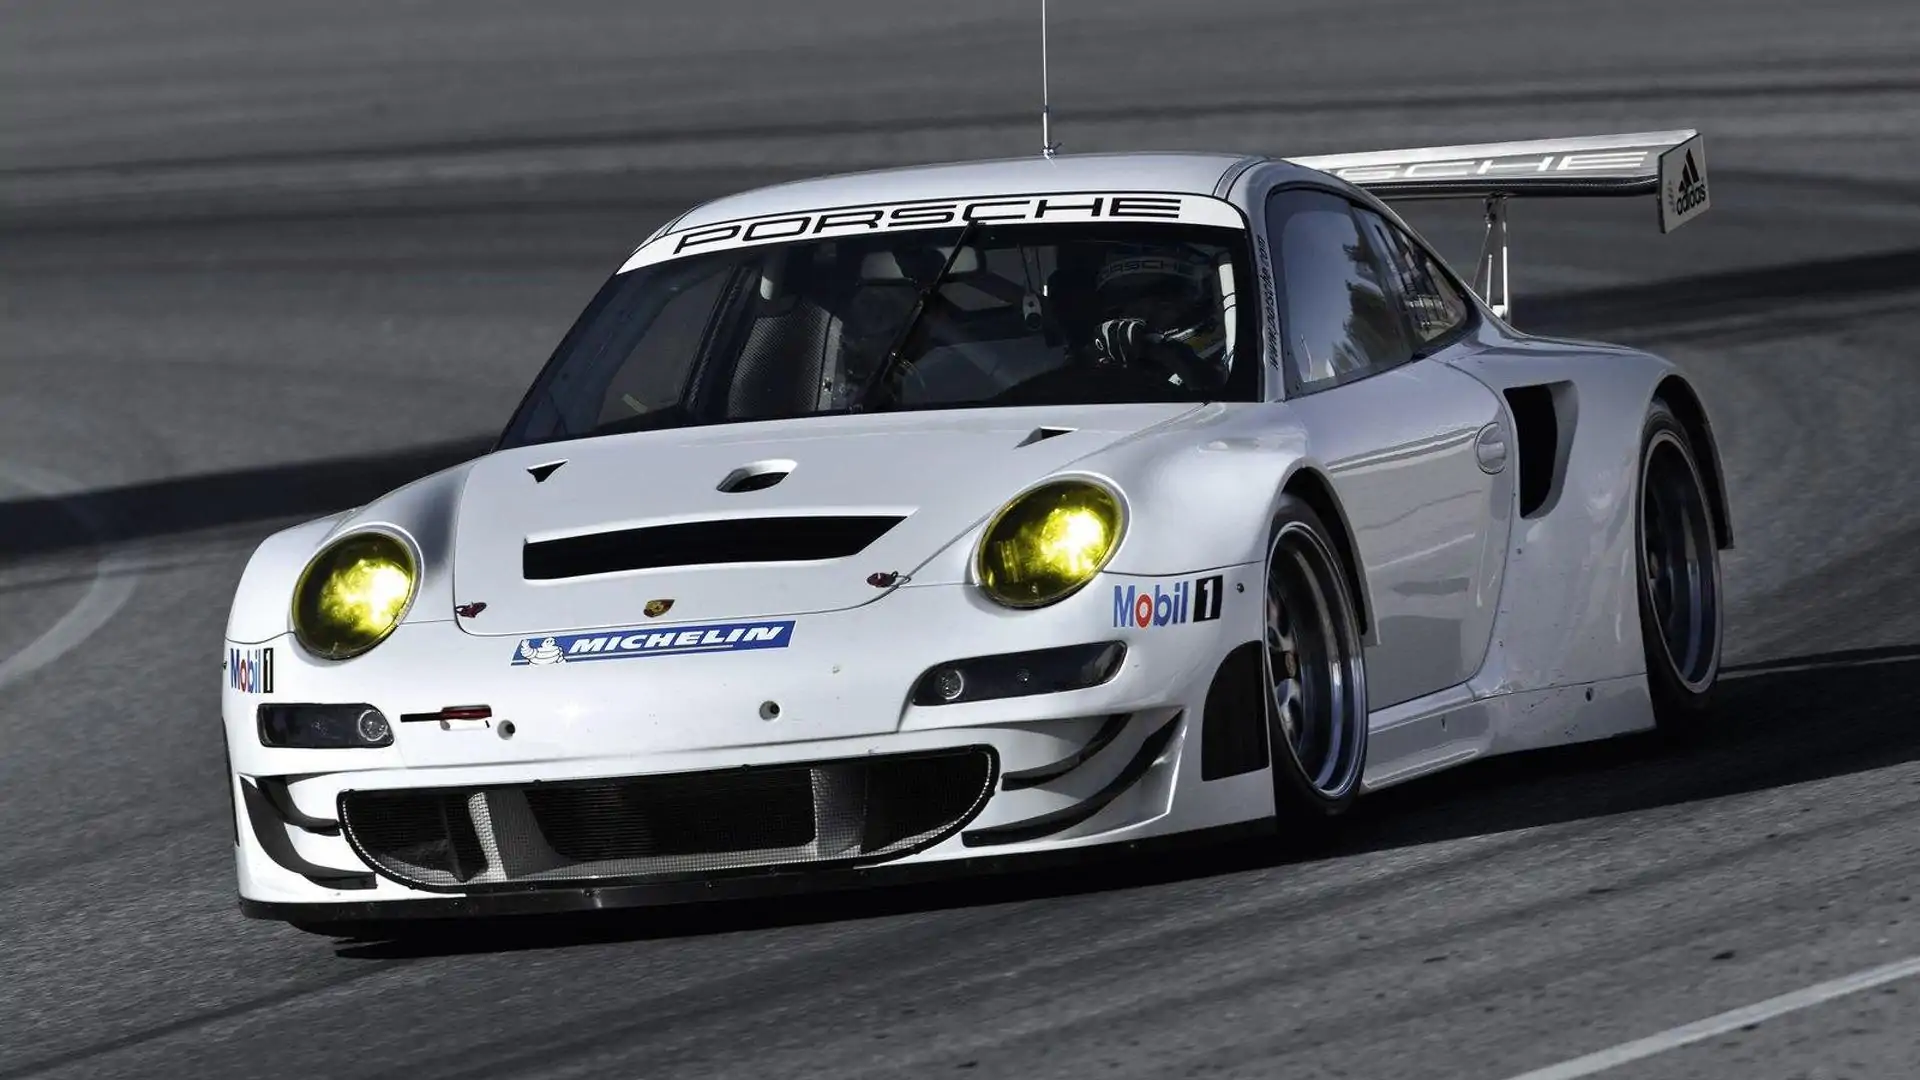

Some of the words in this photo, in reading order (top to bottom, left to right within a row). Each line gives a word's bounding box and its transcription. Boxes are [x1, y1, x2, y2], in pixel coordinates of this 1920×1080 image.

[1325, 151, 1648, 178] SCHE
[1676, 183, 1706, 215] adidas
[673, 197, 1181, 254] PORSCHE
[1257, 234, 1279, 371] www.porsche.com
[1113, 581, 1188, 628] Mobil
[568, 626, 784, 654] MICHELIN
[229, 648, 261, 693] Mobil
